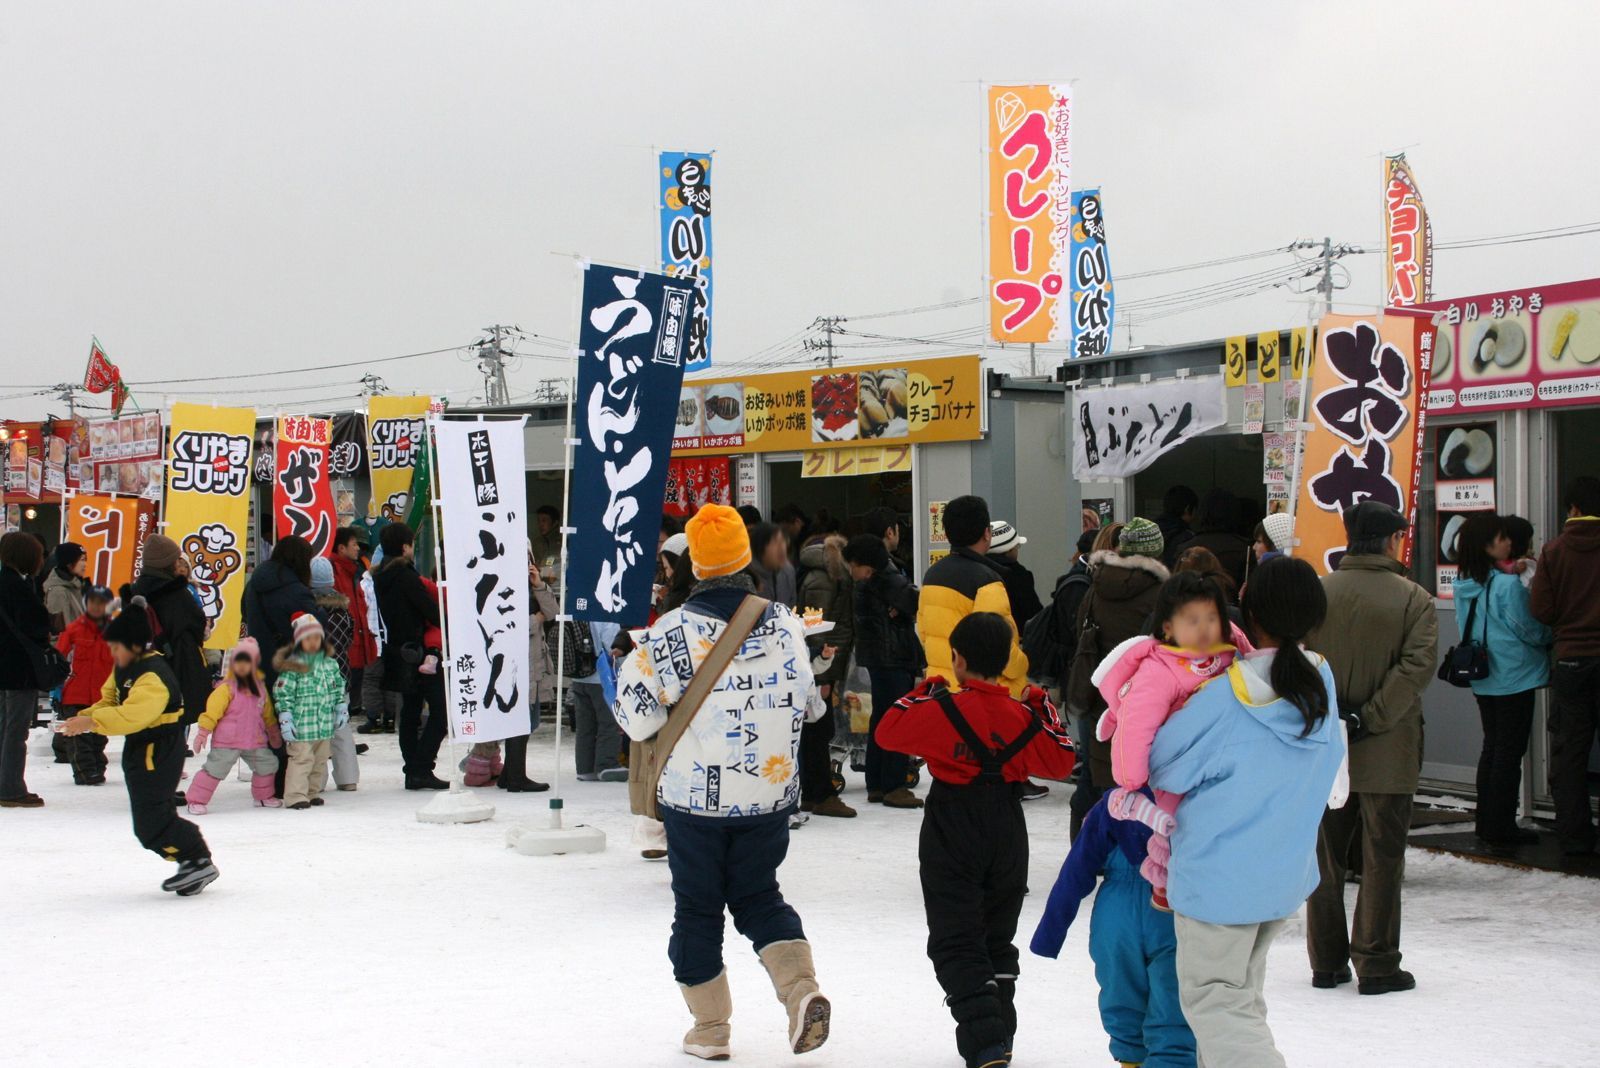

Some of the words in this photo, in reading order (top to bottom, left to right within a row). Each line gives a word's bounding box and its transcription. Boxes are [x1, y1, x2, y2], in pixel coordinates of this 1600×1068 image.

[996, 111, 1062, 331] クレープ
[1446, 302, 1479, 325] 白い
[1491, 292, 1543, 319] おやき
[745, 389, 807, 410] お好みいか焼
[909, 376, 954, 398] クレープ
[745, 411, 807, 433] いかポッポ焼
[909, 402, 976, 423] チョコバナナ
[172, 430, 250, 461] くりやま
[805, 443, 910, 477] クレープ
[1307, 321, 1409, 579] おや
[172, 459, 249, 495] コロッケ
[469, 431, 499, 505] ホエー豚
